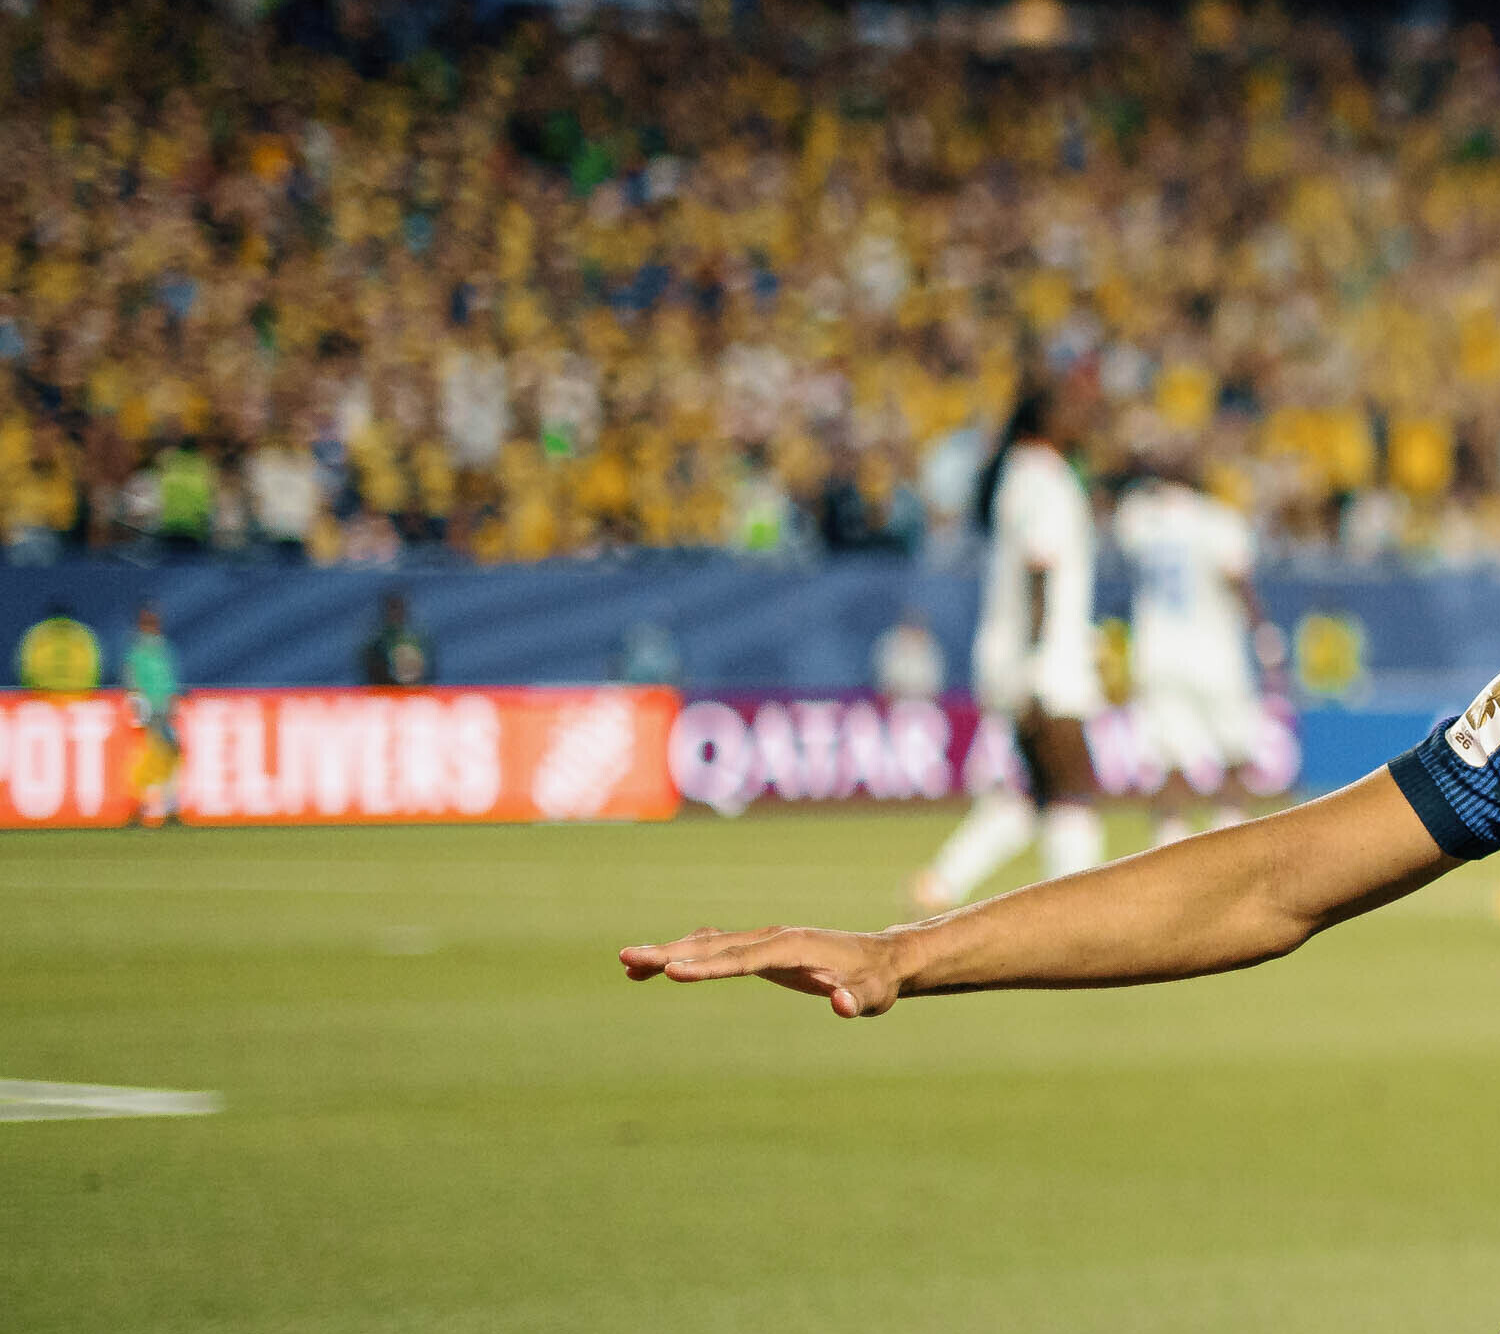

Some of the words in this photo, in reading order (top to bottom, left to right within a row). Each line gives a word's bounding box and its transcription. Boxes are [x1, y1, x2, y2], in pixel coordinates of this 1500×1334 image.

[0, 699, 116, 821] OT
[668, 699, 952, 817] QATAR
[1455, 732, 1473, 750] 26
